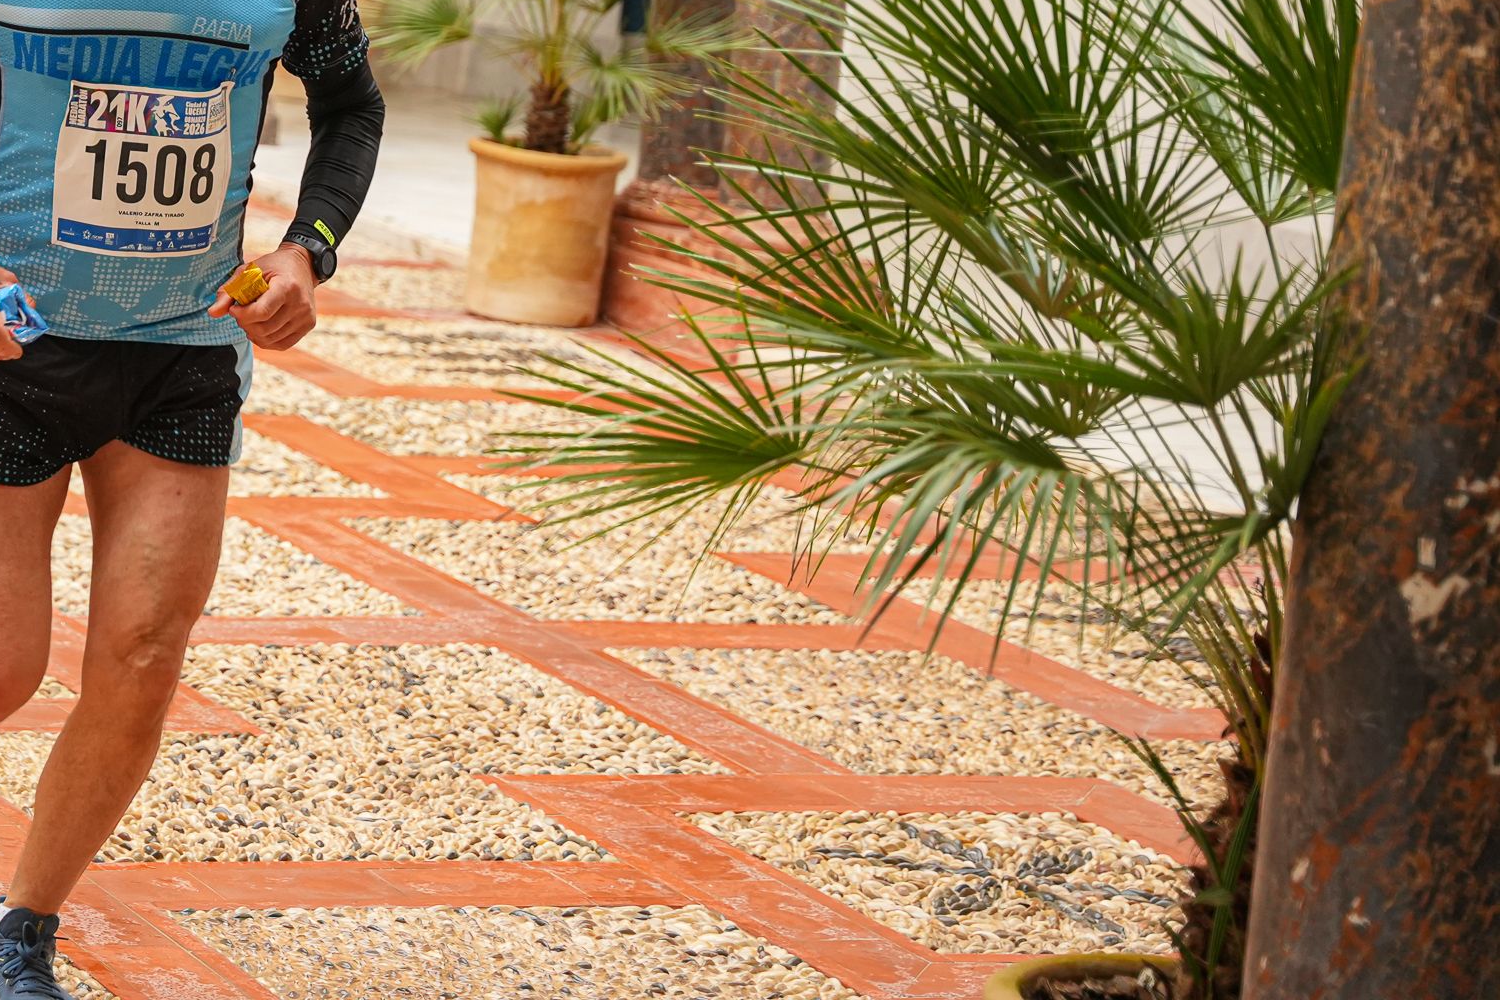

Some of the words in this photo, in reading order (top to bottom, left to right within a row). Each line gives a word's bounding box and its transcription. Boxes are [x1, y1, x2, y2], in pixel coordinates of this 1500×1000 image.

[191, 16, 251, 42] BAENA
[12, 32, 141, 86] MEDIA
[88, 90, 150, 134] 21K
[183, 123, 205, 136] 2026
[85, 139, 216, 206] 1508
